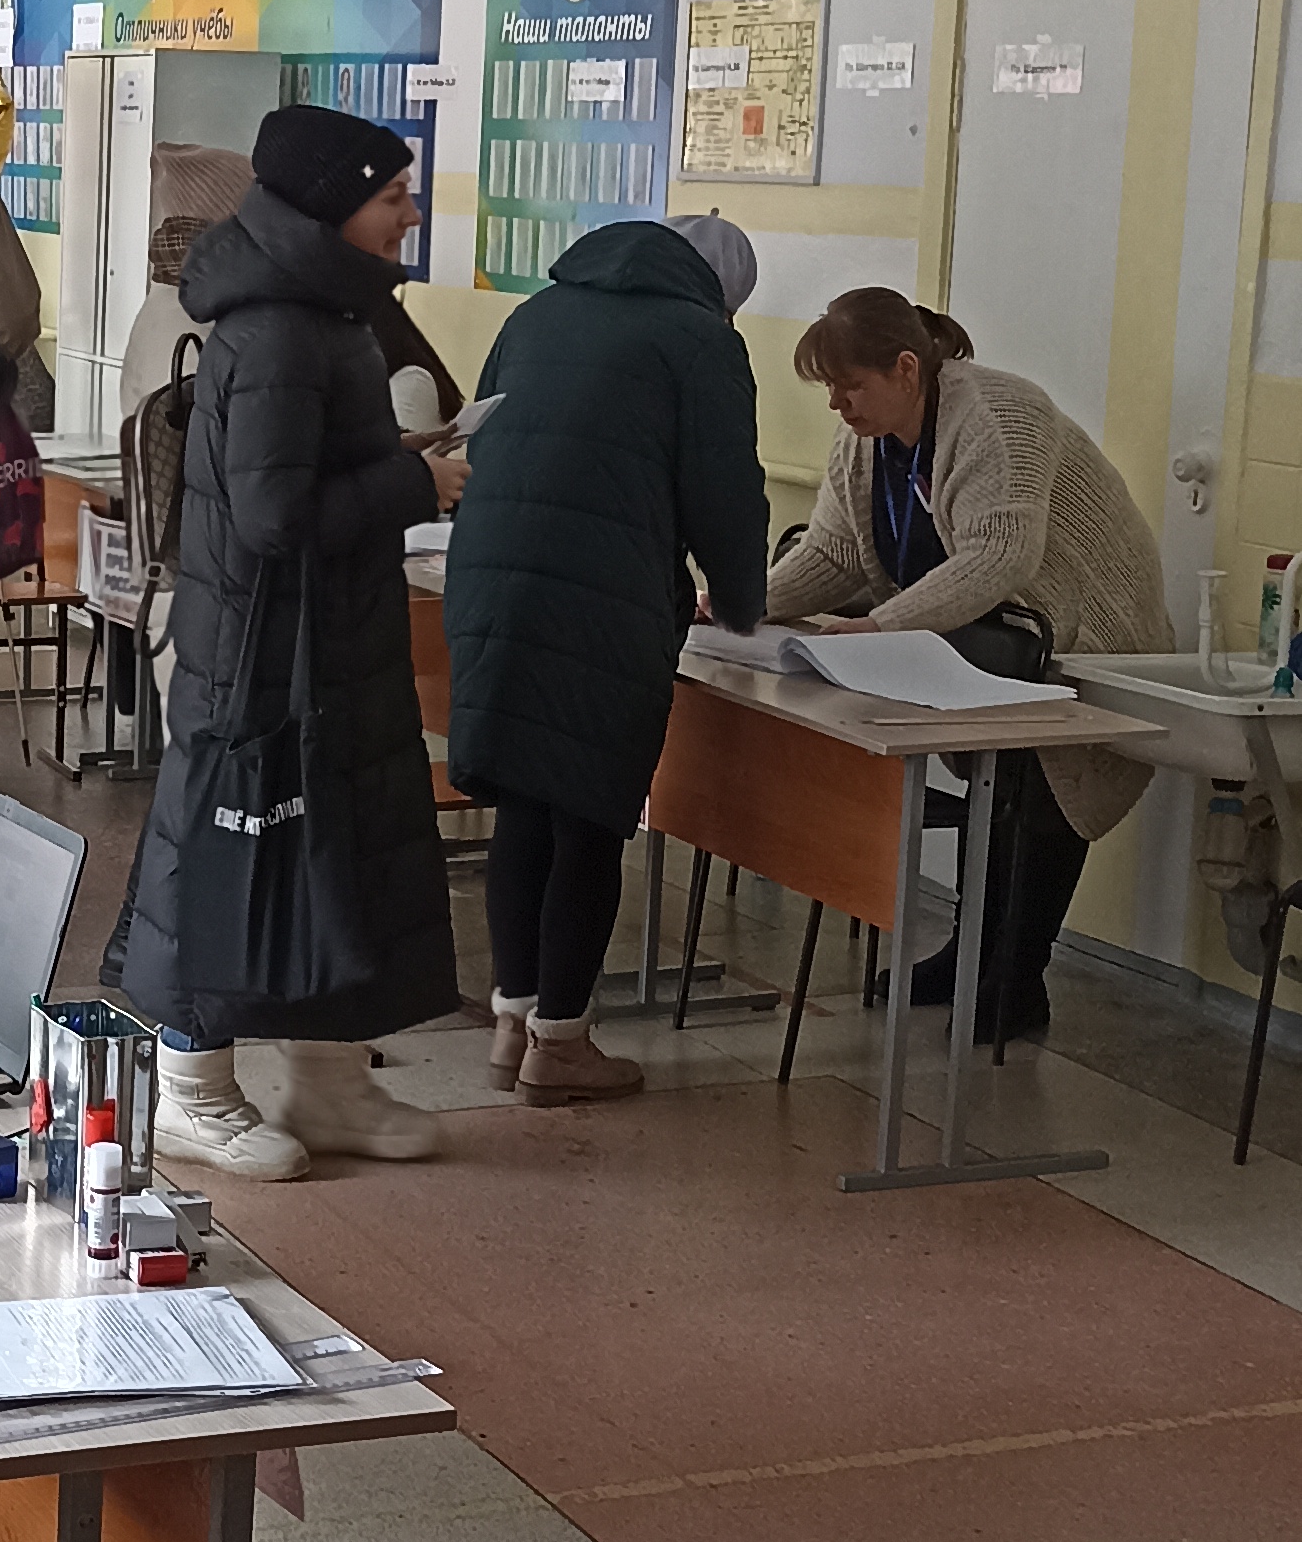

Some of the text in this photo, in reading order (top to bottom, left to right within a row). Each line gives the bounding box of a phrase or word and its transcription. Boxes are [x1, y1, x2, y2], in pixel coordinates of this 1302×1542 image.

[114, 7, 234, 50] Отличники учёбы
[501, 11, 653, 44] Наши таланты
